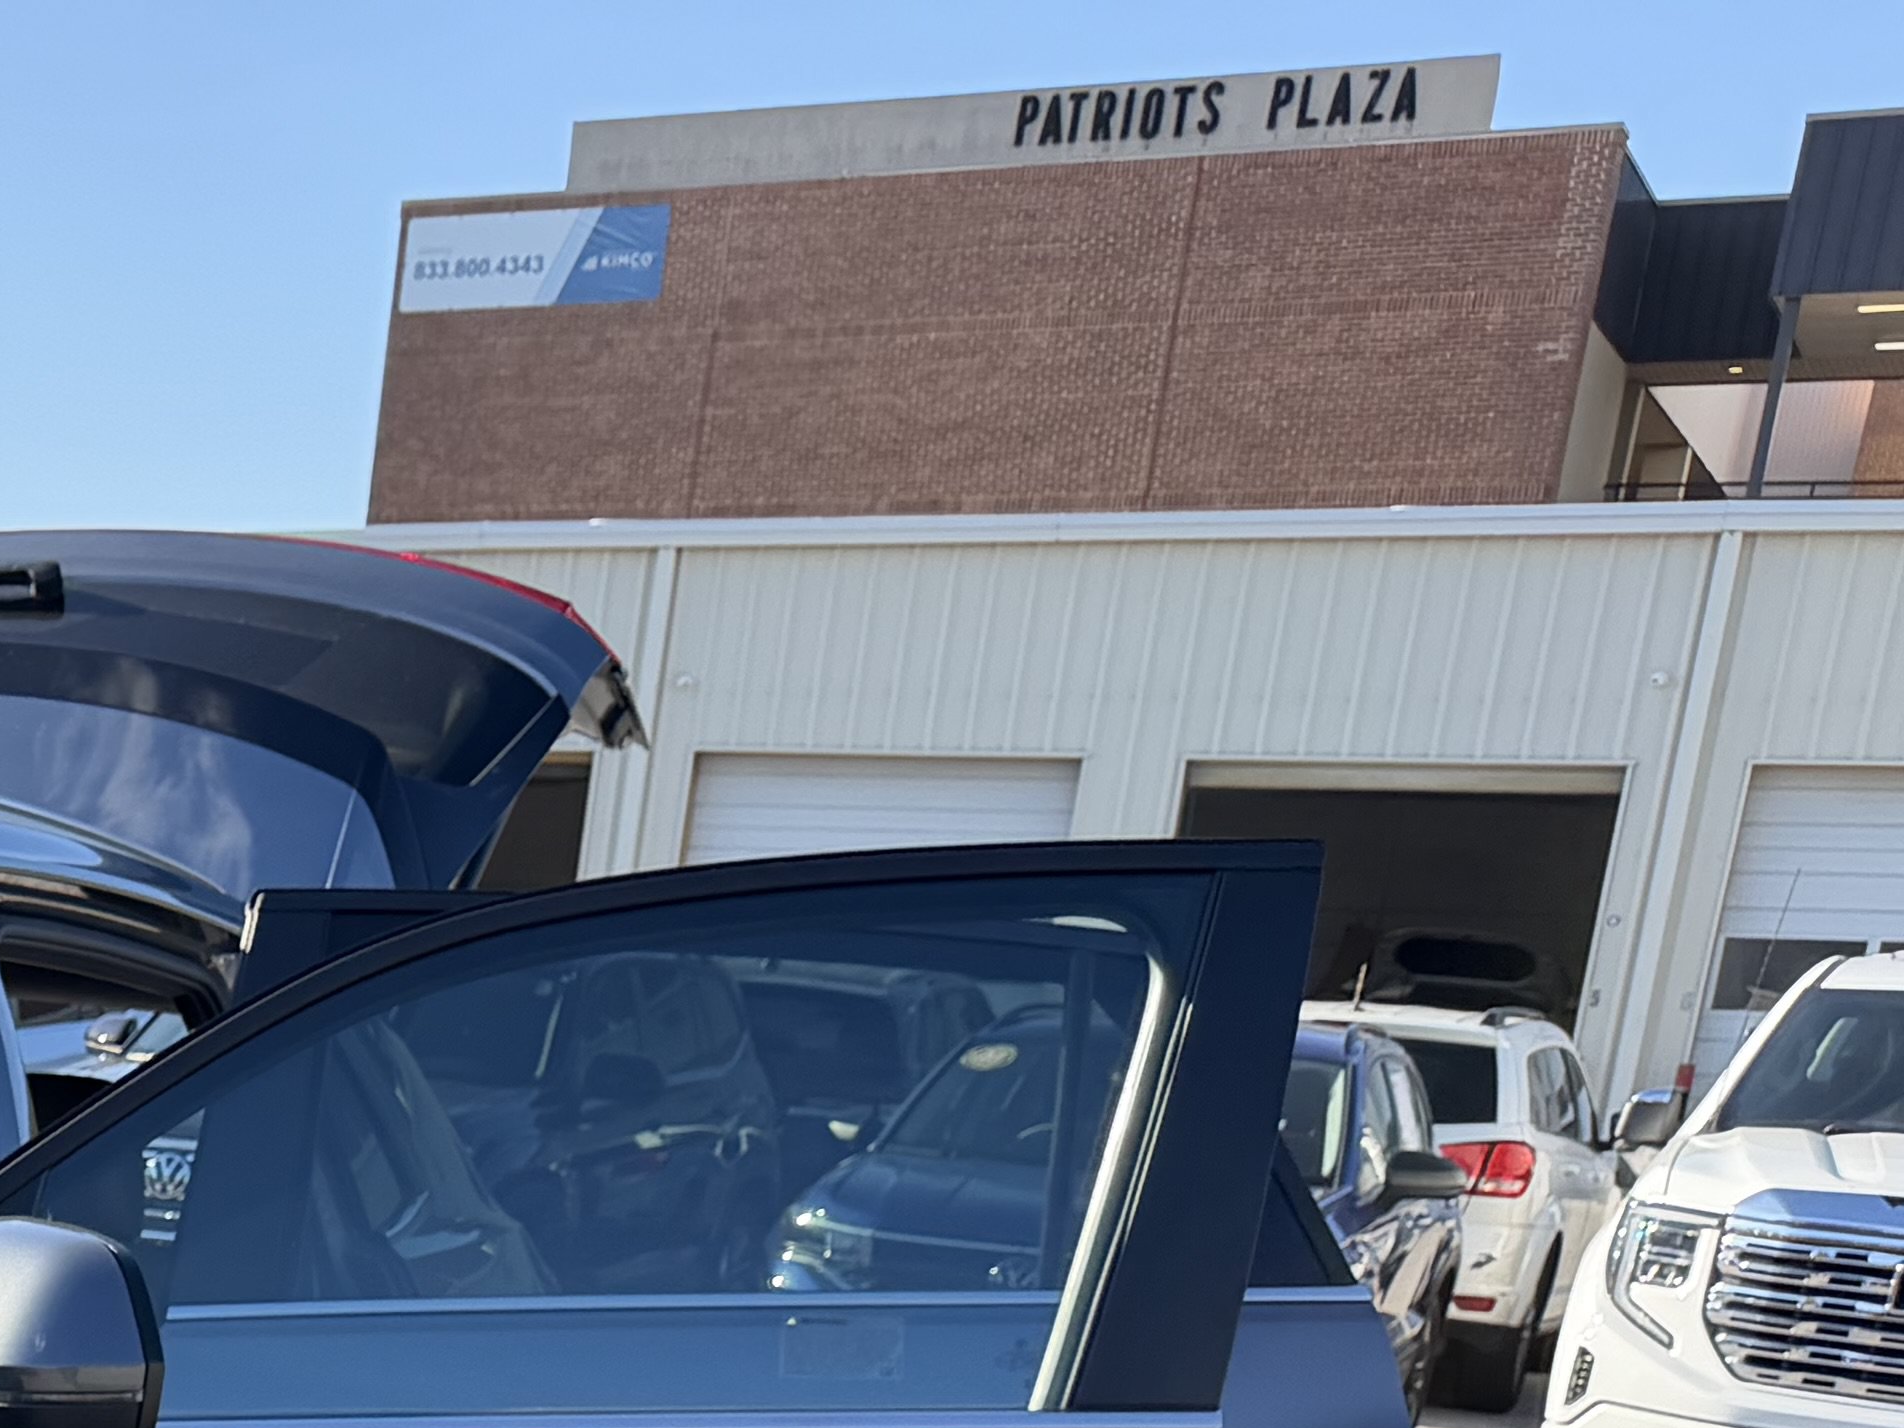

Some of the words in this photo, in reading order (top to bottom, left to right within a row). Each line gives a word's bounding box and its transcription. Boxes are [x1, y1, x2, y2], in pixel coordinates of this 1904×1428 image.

[1013, 80, 1226, 147] PATRIOTS
[1266, 66, 1418, 130] PLAZA
[413, 253, 545, 281] 833.800.4343
